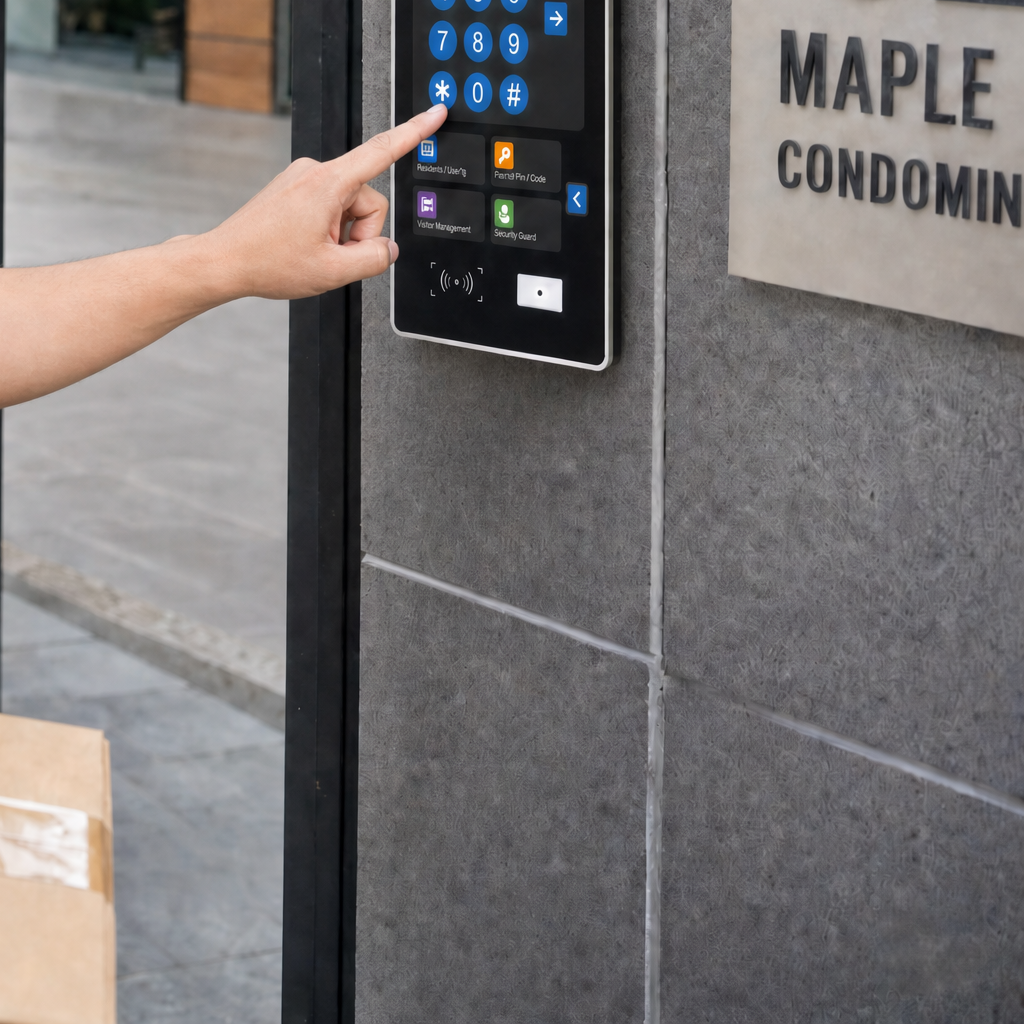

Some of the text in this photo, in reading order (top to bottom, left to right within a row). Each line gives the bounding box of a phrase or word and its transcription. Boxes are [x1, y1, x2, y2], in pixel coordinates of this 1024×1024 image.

[437, 30, 520, 55] 7 8 9
[779, 29, 994, 130] MAPLE
[472, 81, 484, 104] 0
[507, 82, 521, 107] #
[530, 174, 547, 184] Code
[777, 139, 1022, 228] CONDOMIN
